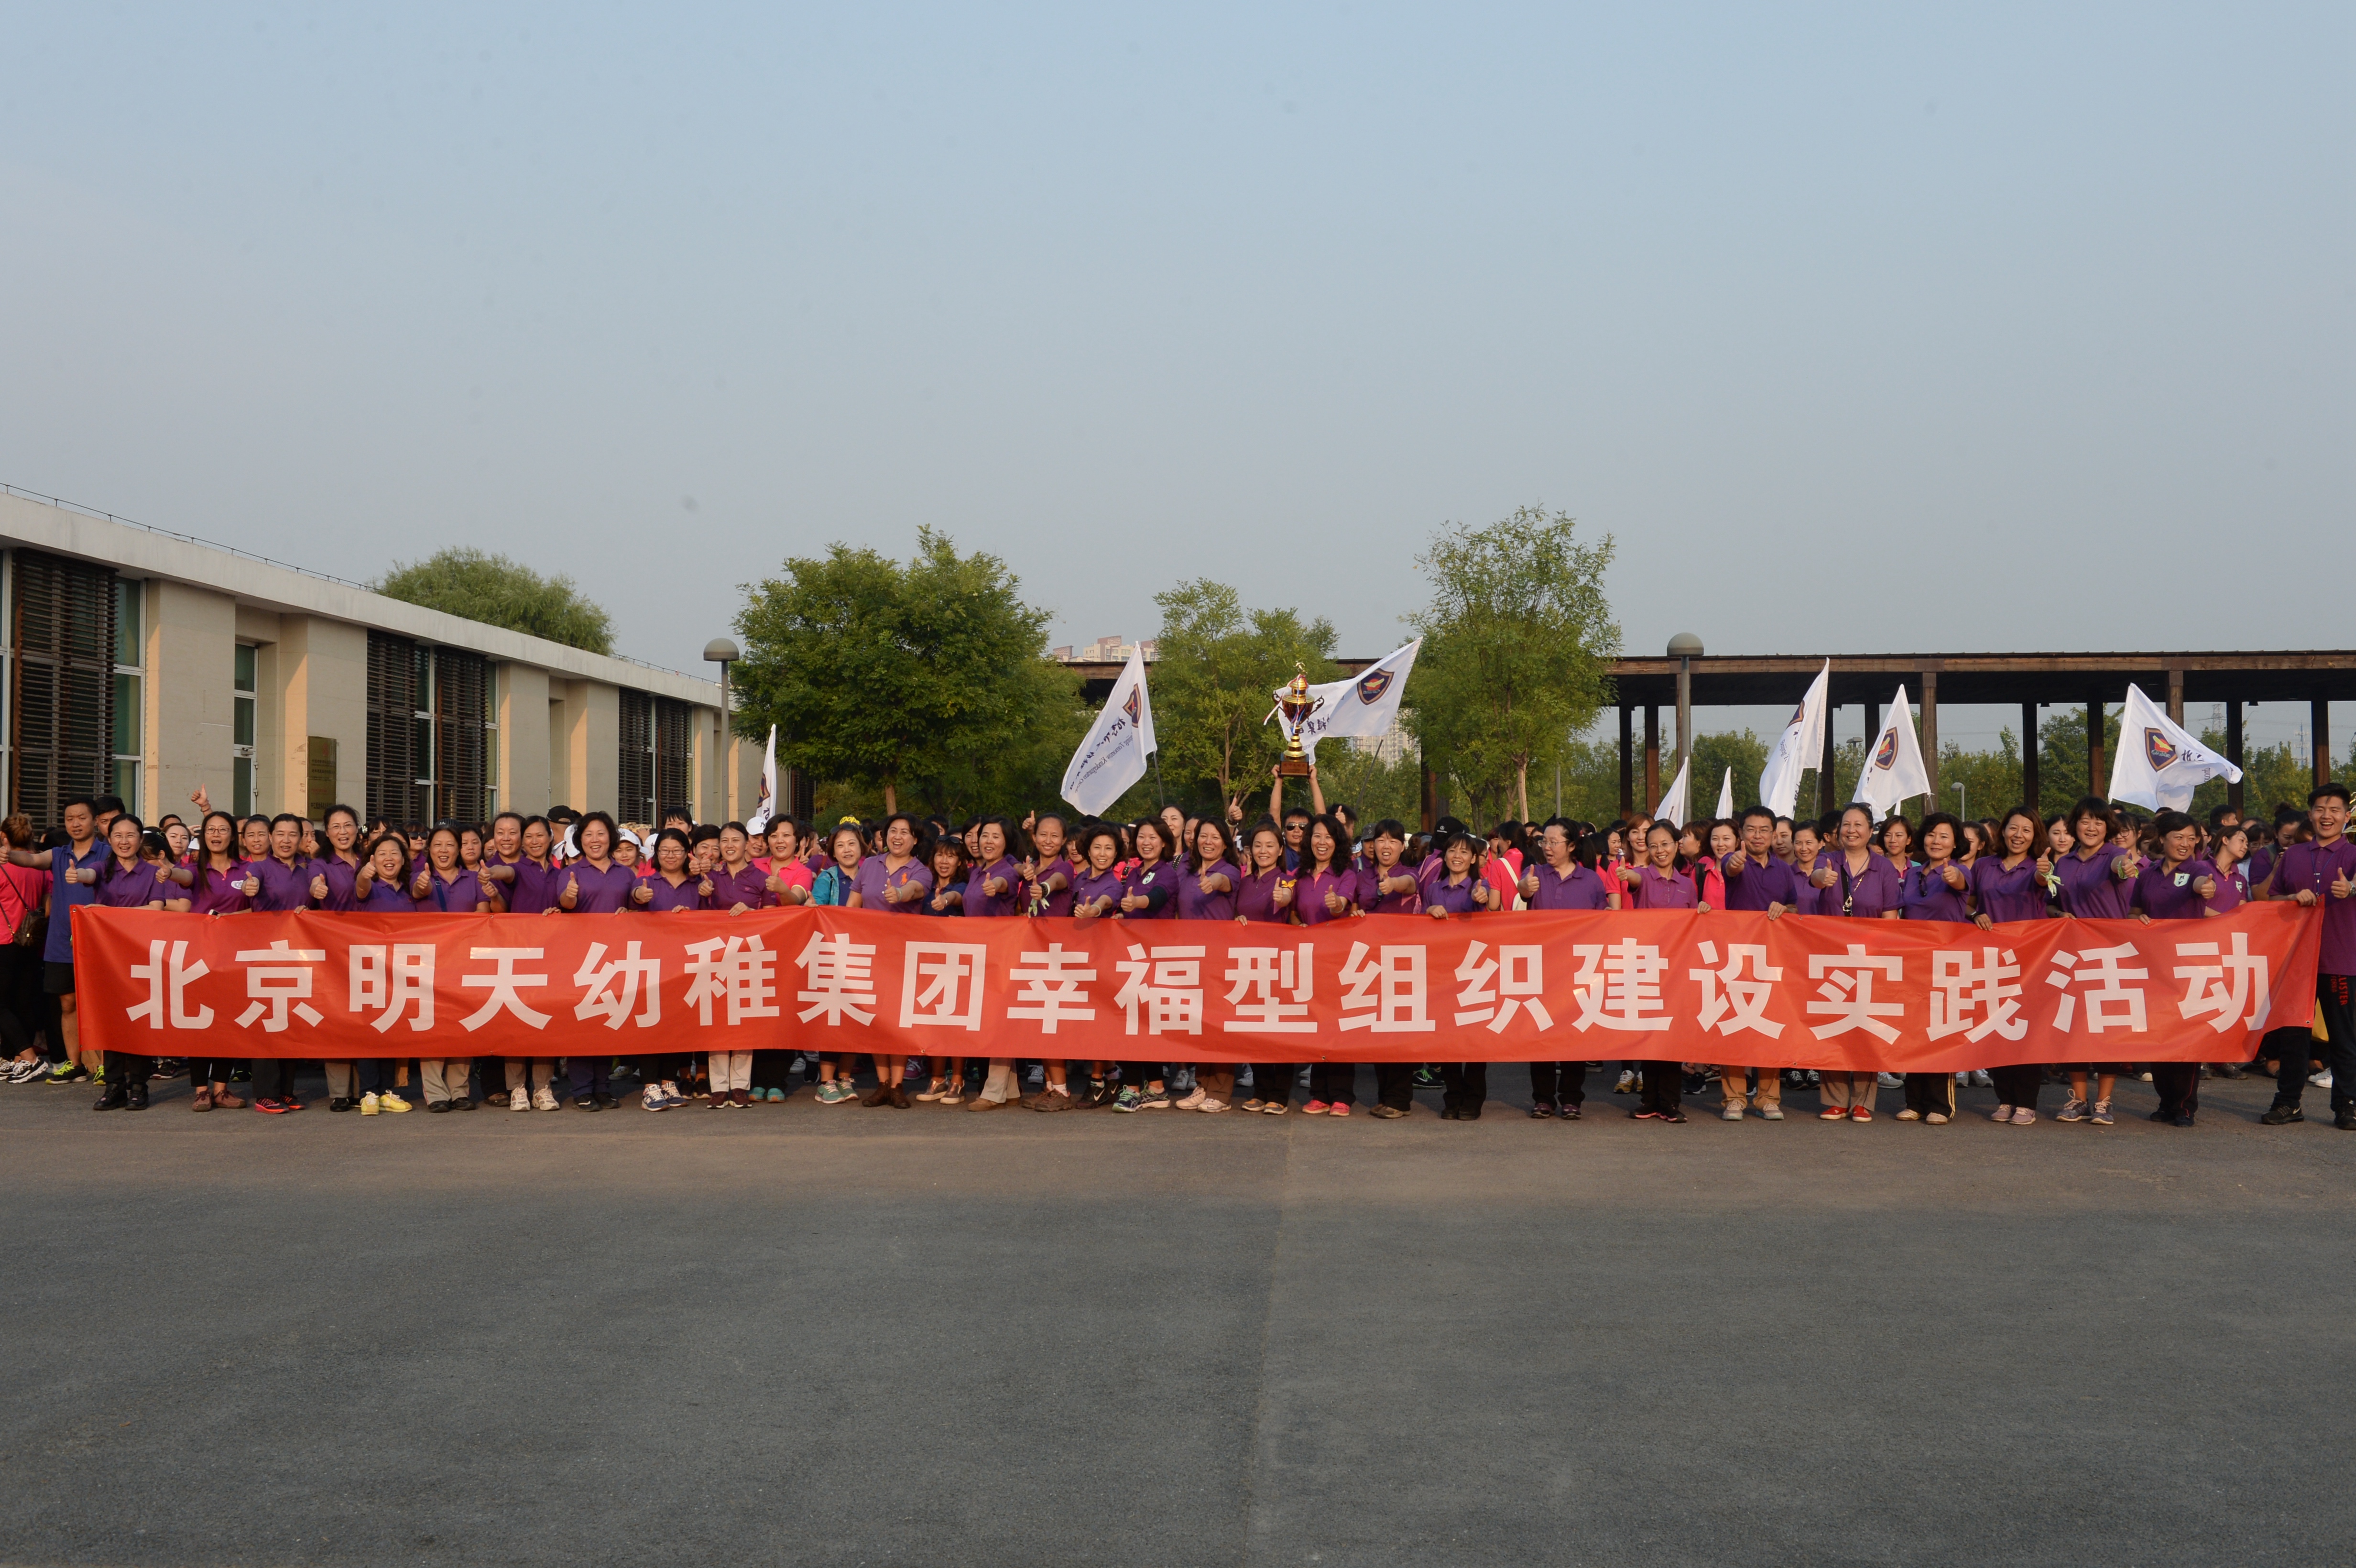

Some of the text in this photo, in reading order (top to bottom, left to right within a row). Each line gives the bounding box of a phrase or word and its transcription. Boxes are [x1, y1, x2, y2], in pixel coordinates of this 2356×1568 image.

[126, 931, 2271, 1045] 北京明天幼稚集团幸福型组织建设实践活动
